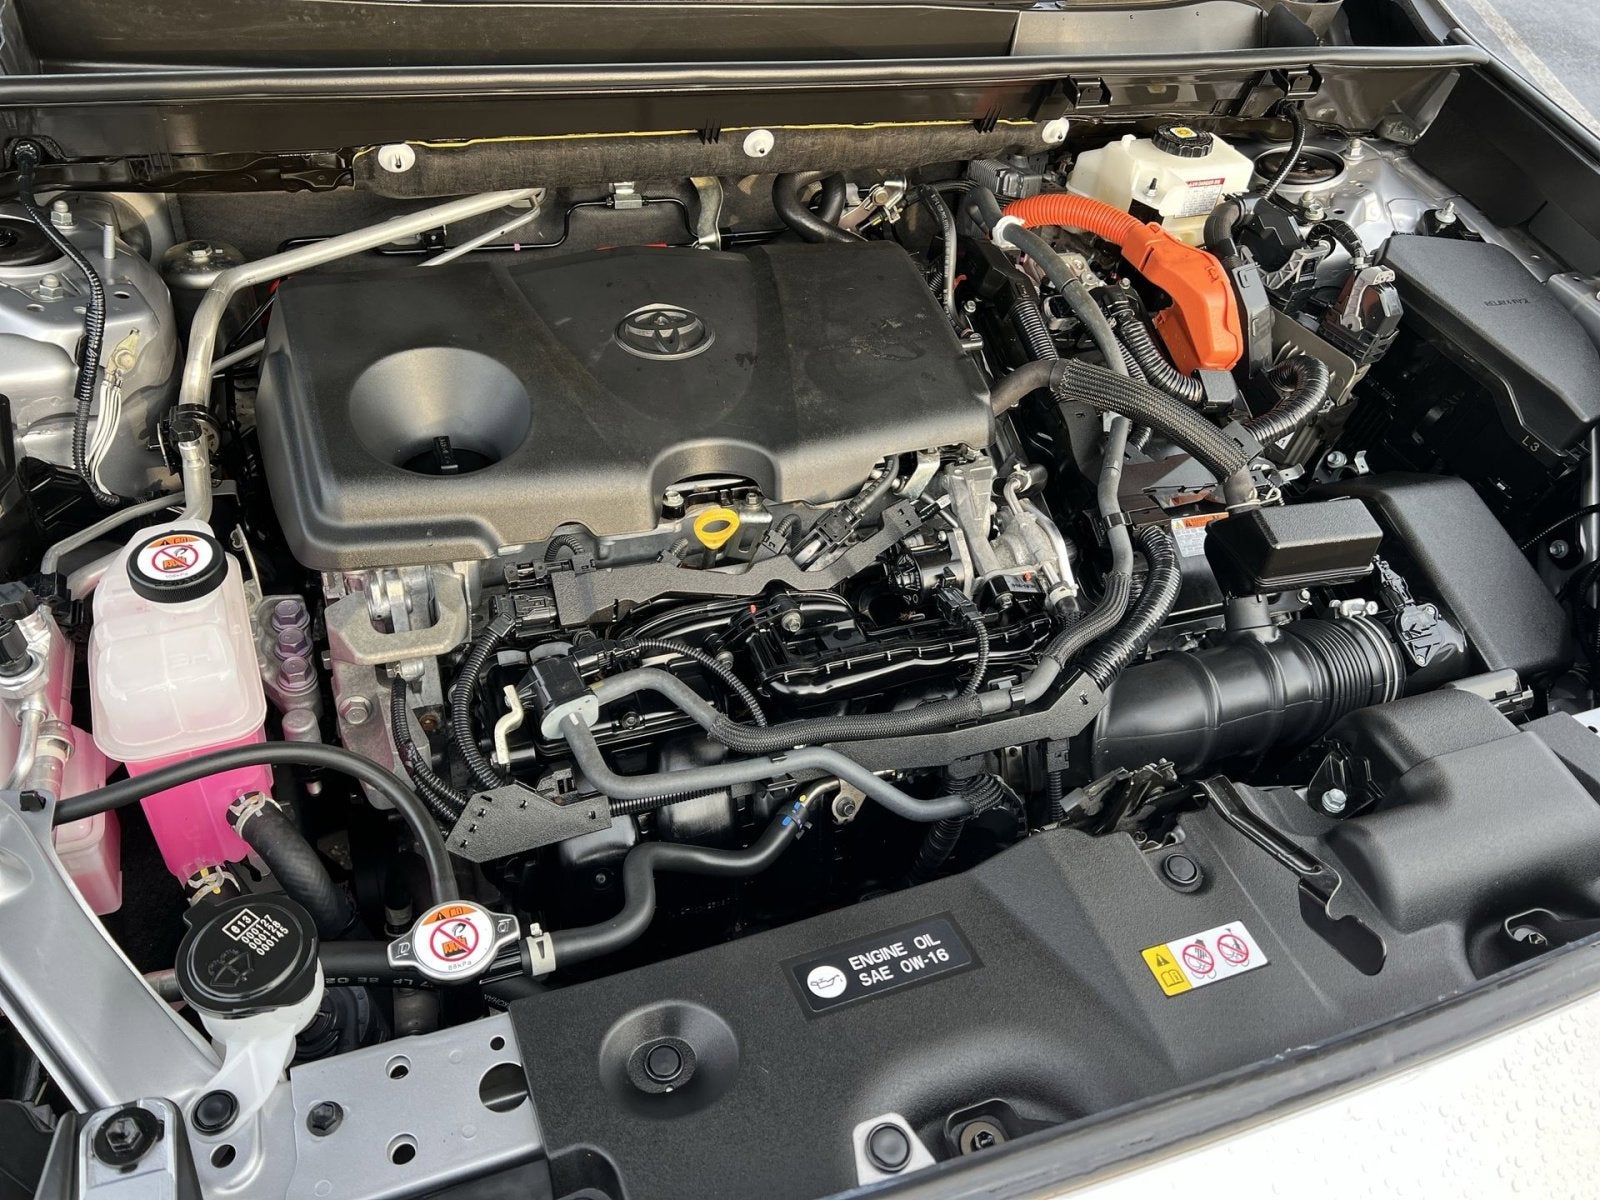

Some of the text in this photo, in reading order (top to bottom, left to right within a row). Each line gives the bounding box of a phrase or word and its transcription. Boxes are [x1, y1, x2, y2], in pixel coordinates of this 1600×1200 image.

[241, 914, 273, 944] 000127
[248, 920, 281, 950] 000128
[256, 927, 289, 956] 000145
[847, 933, 941, 971] ENGINE OIL
[858, 948, 950, 987] SAE 0W-16
